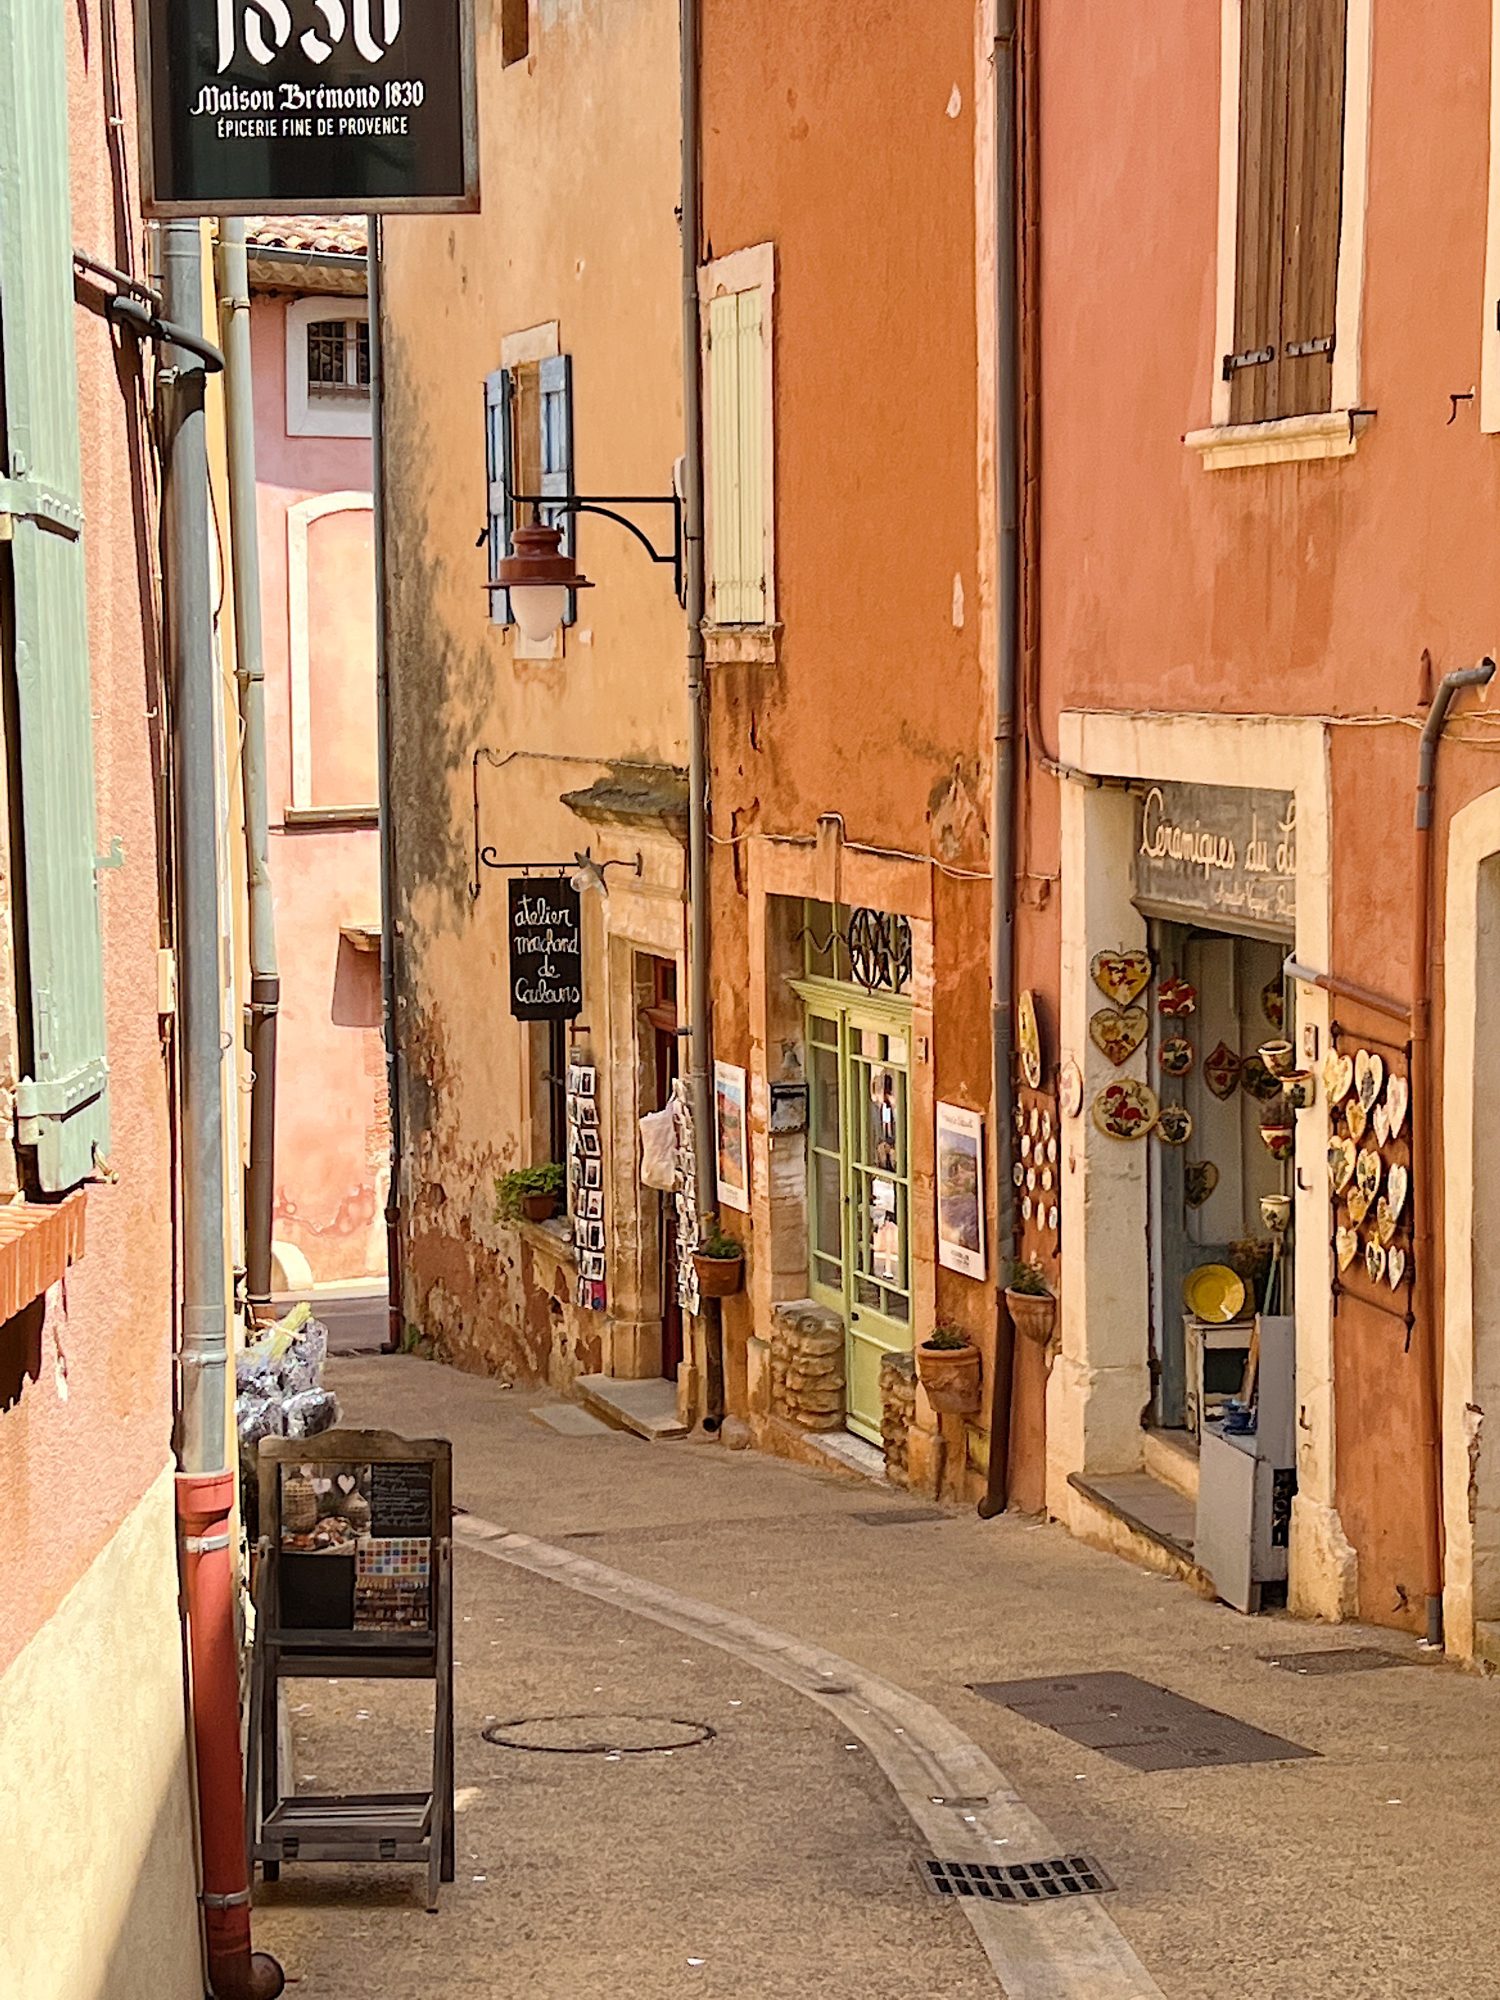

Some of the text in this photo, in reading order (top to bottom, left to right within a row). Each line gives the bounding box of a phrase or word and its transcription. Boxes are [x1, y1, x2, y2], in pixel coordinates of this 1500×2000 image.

[190, 80, 424, 115] Maison Brémond 1830
[217, 115, 408, 138] ÉPICERIE FINE DE PROVENCE
[1244, 813, 1271, 872] du
[514, 894, 573, 927] atelier
[537, 954, 561, 979] de
